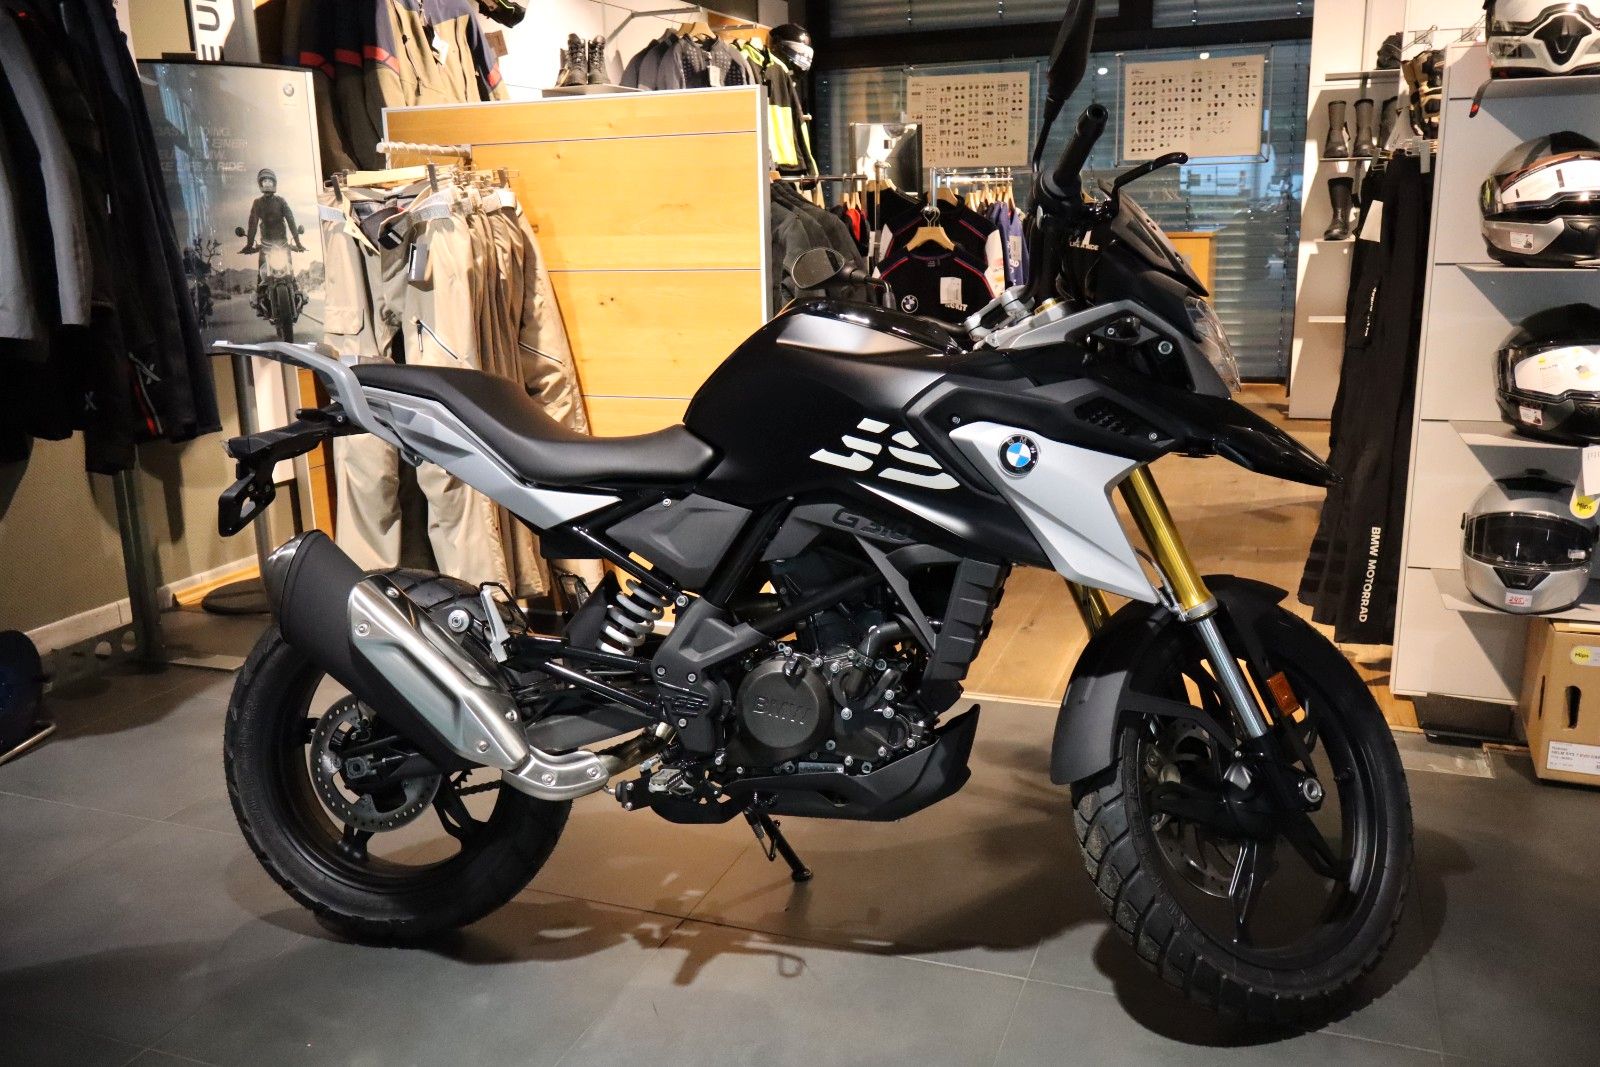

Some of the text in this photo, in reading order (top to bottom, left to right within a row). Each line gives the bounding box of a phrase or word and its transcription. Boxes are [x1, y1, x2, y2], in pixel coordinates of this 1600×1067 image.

[1359, 526, 1382, 623] BMW MOTORRAD
[752, 696, 813, 725] BMW
